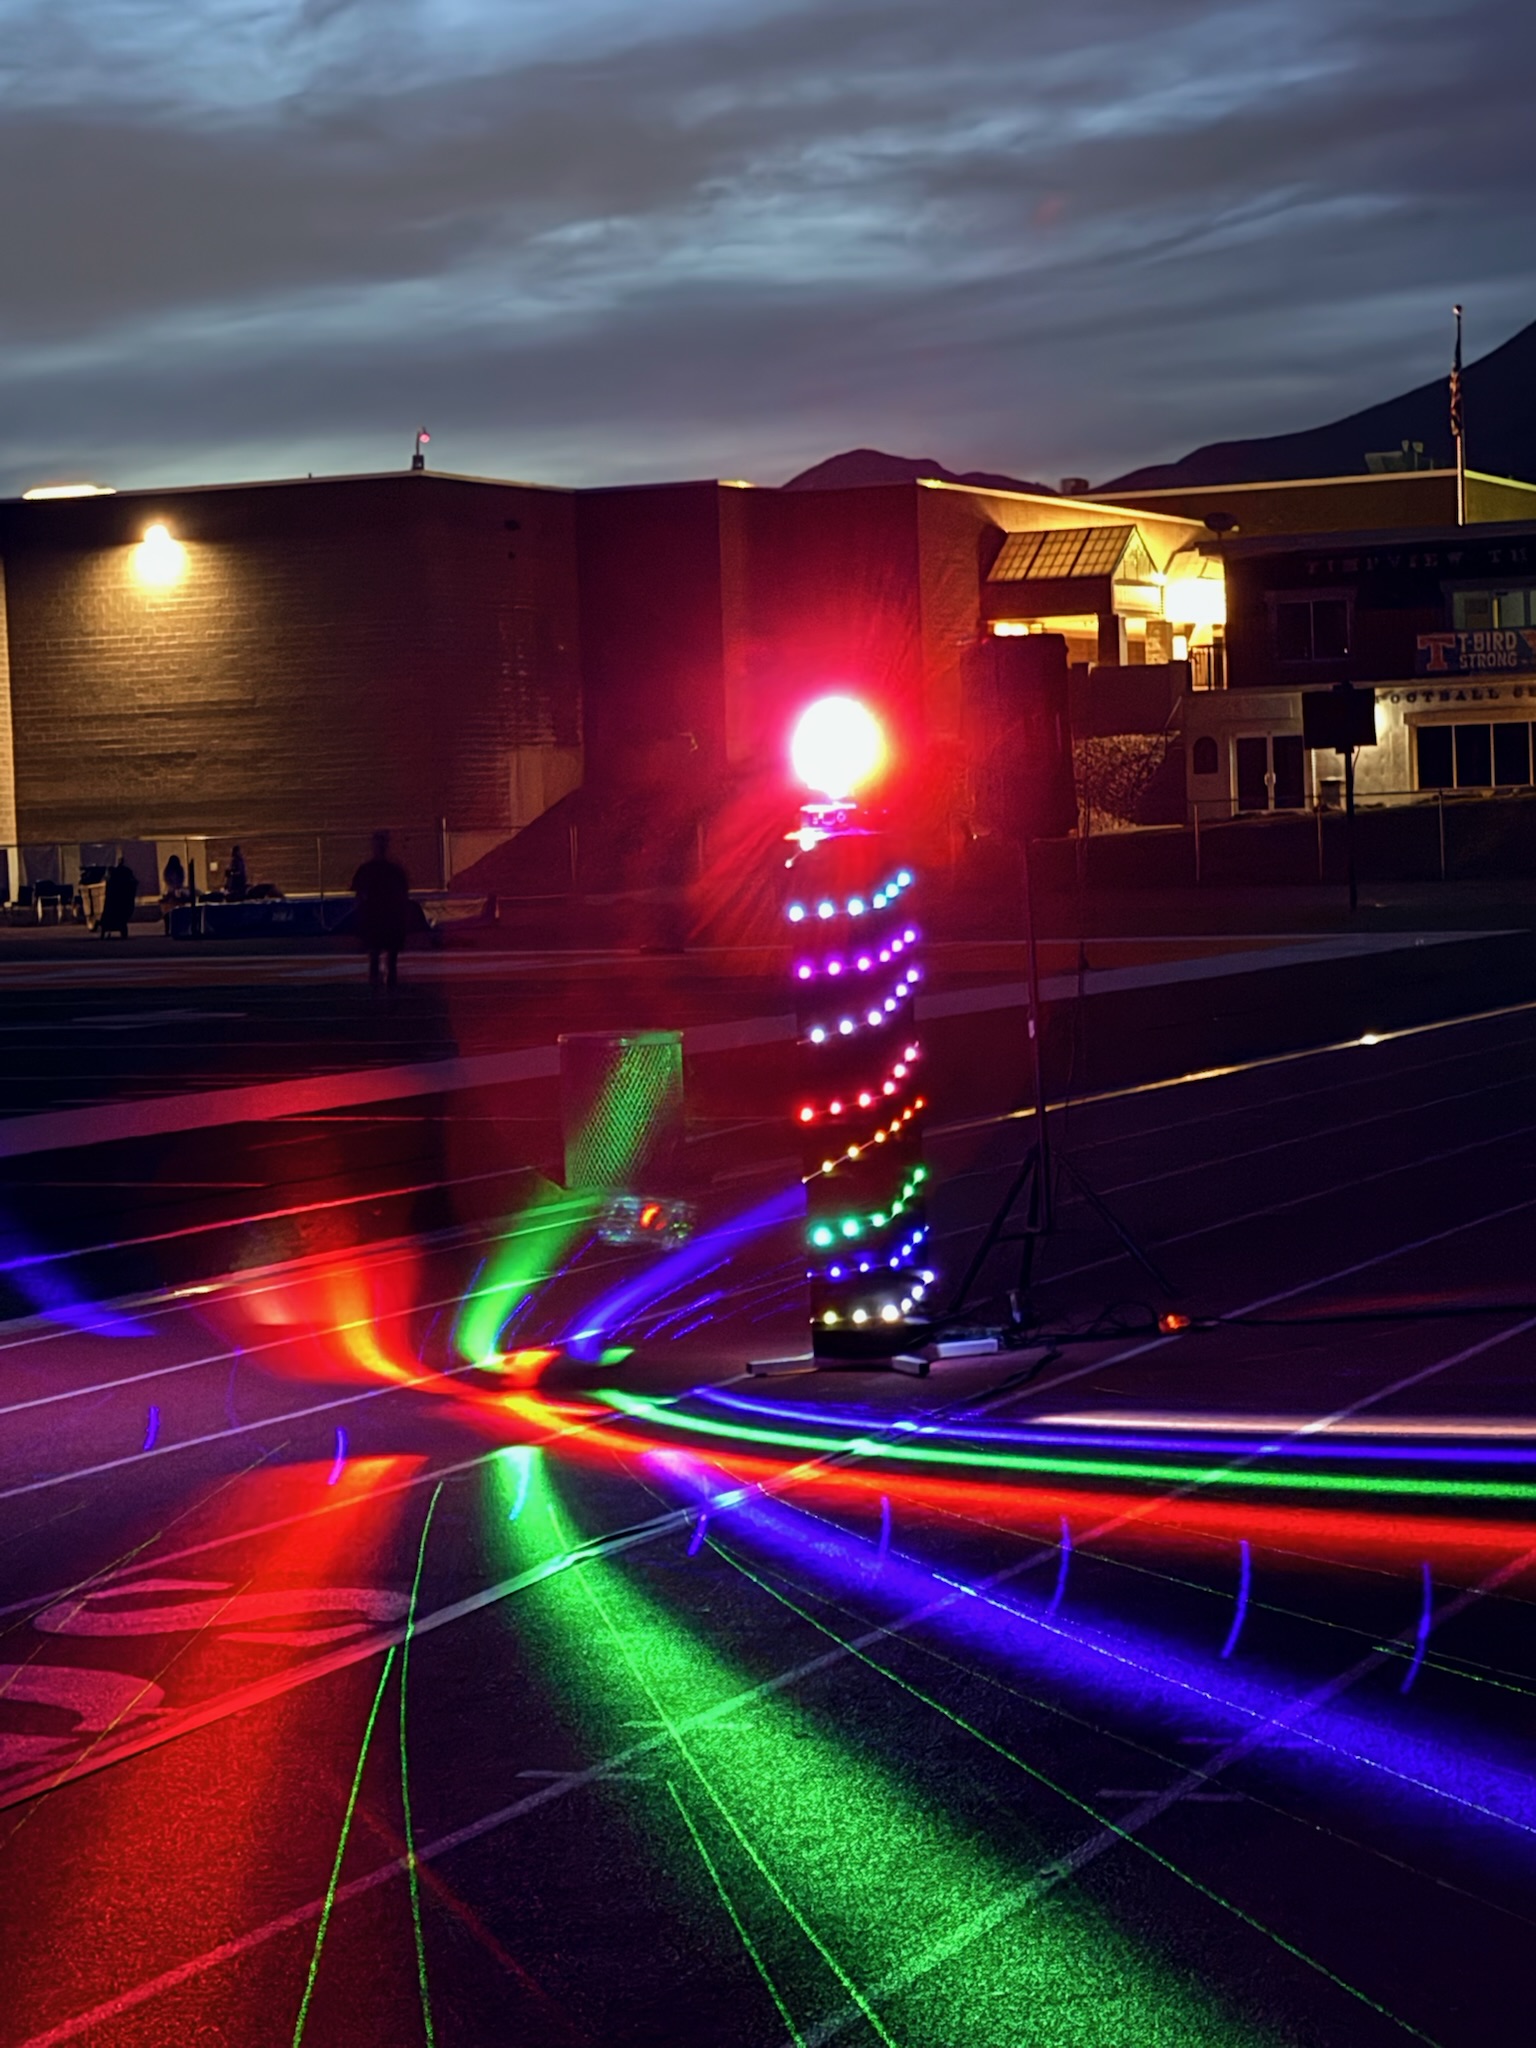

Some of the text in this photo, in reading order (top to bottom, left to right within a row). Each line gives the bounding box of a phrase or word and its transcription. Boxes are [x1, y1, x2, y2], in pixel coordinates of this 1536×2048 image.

[1416, 633, 1456, 670] T
[1457, 631, 1518, 652] T-BIRD
[1459, 652, 1518, 669] STRONG
